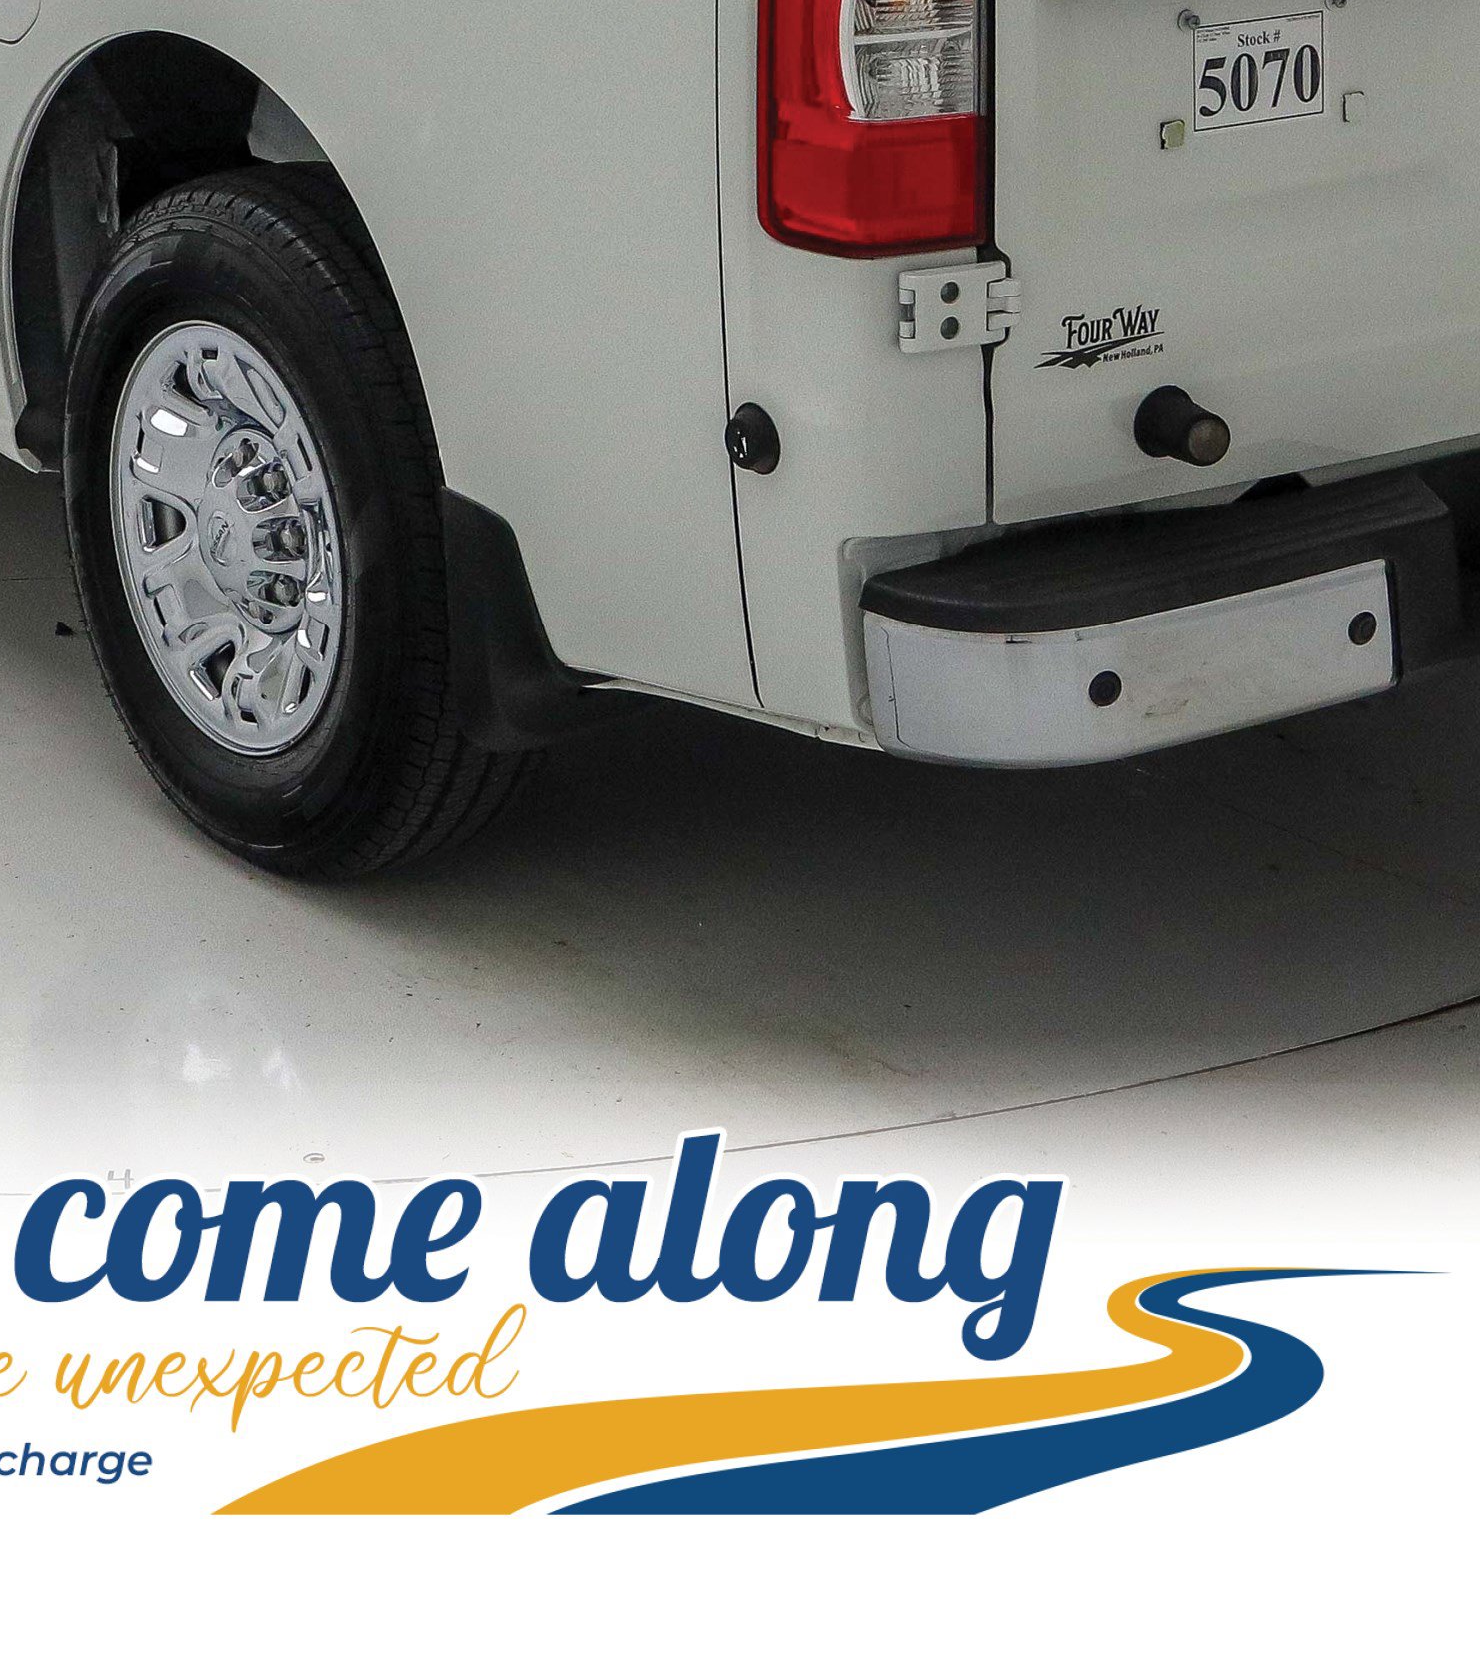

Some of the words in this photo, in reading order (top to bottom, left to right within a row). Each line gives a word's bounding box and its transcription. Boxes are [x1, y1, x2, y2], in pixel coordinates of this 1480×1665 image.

[1237, 30, 1270, 48] Stock
[1273, 29, 1281, 43] #
[1198, 44, 1321, 117] 5070
[1061, 313, 1113, 349] FOUR
[1112, 304, 1160, 337] WAY
[1102, 353, 1120, 363] New
[1120, 346, 1153, 360] Holland,
[1153, 343, 1164, 354] PA
